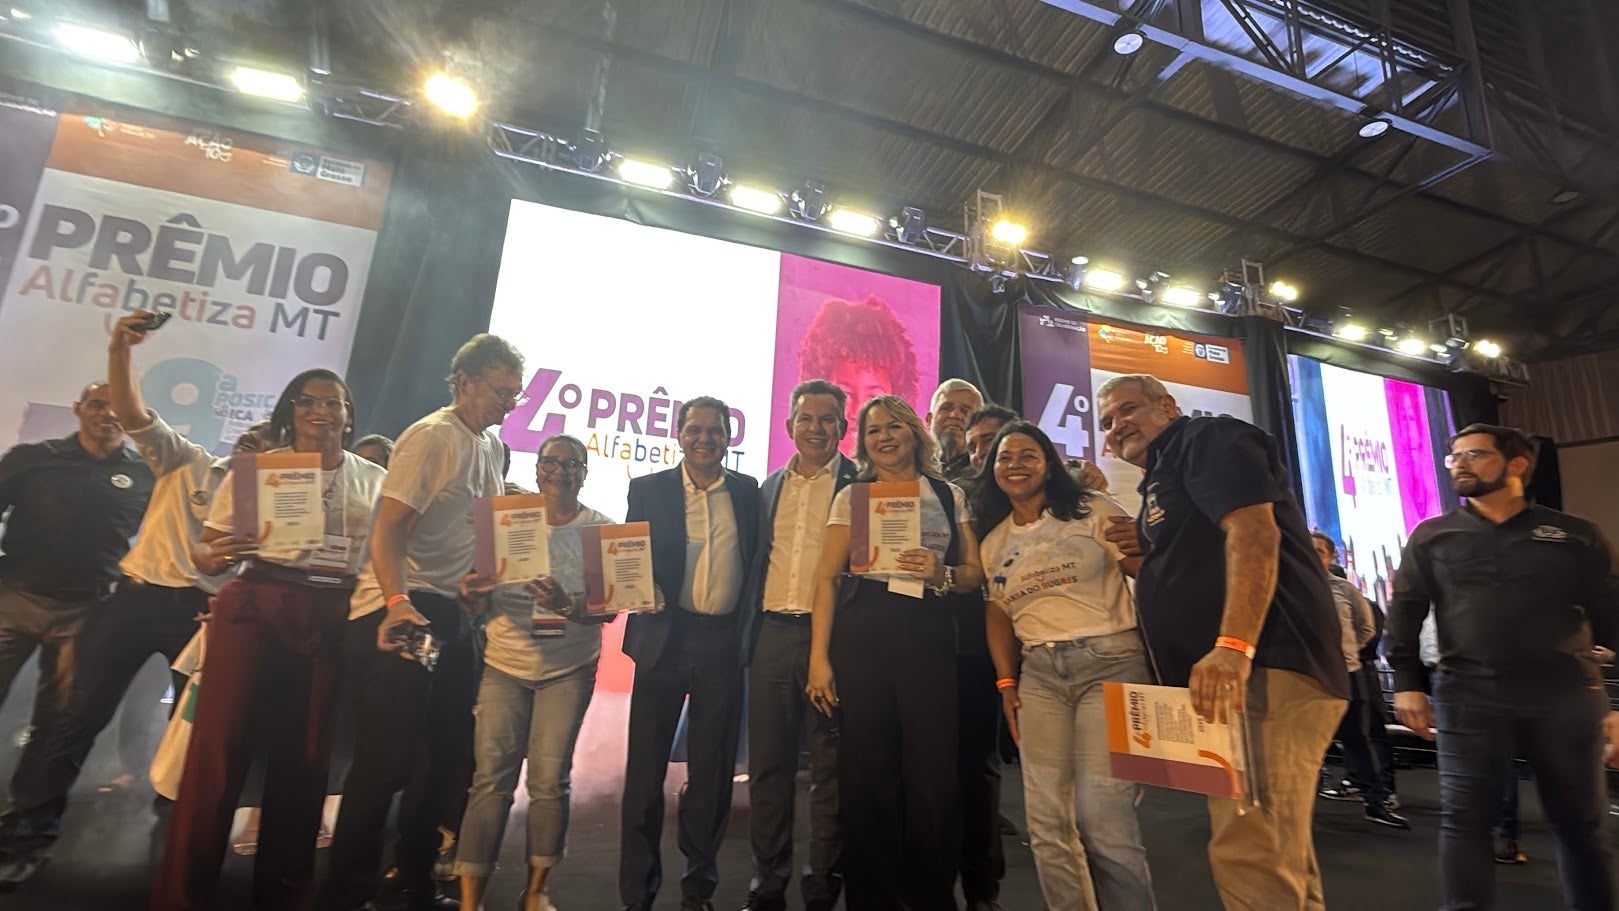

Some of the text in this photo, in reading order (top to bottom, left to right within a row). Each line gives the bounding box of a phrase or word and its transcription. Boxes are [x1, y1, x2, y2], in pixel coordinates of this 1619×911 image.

[28, 203, 348, 306] PRÊMIO
[17, 264, 340, 340] Alfabetiza MT
[499, 367, 746, 454] 4º PRÊO
[1037, 383, 1090, 458] 4º
[586, 432, 688, 466] Alfabeti
